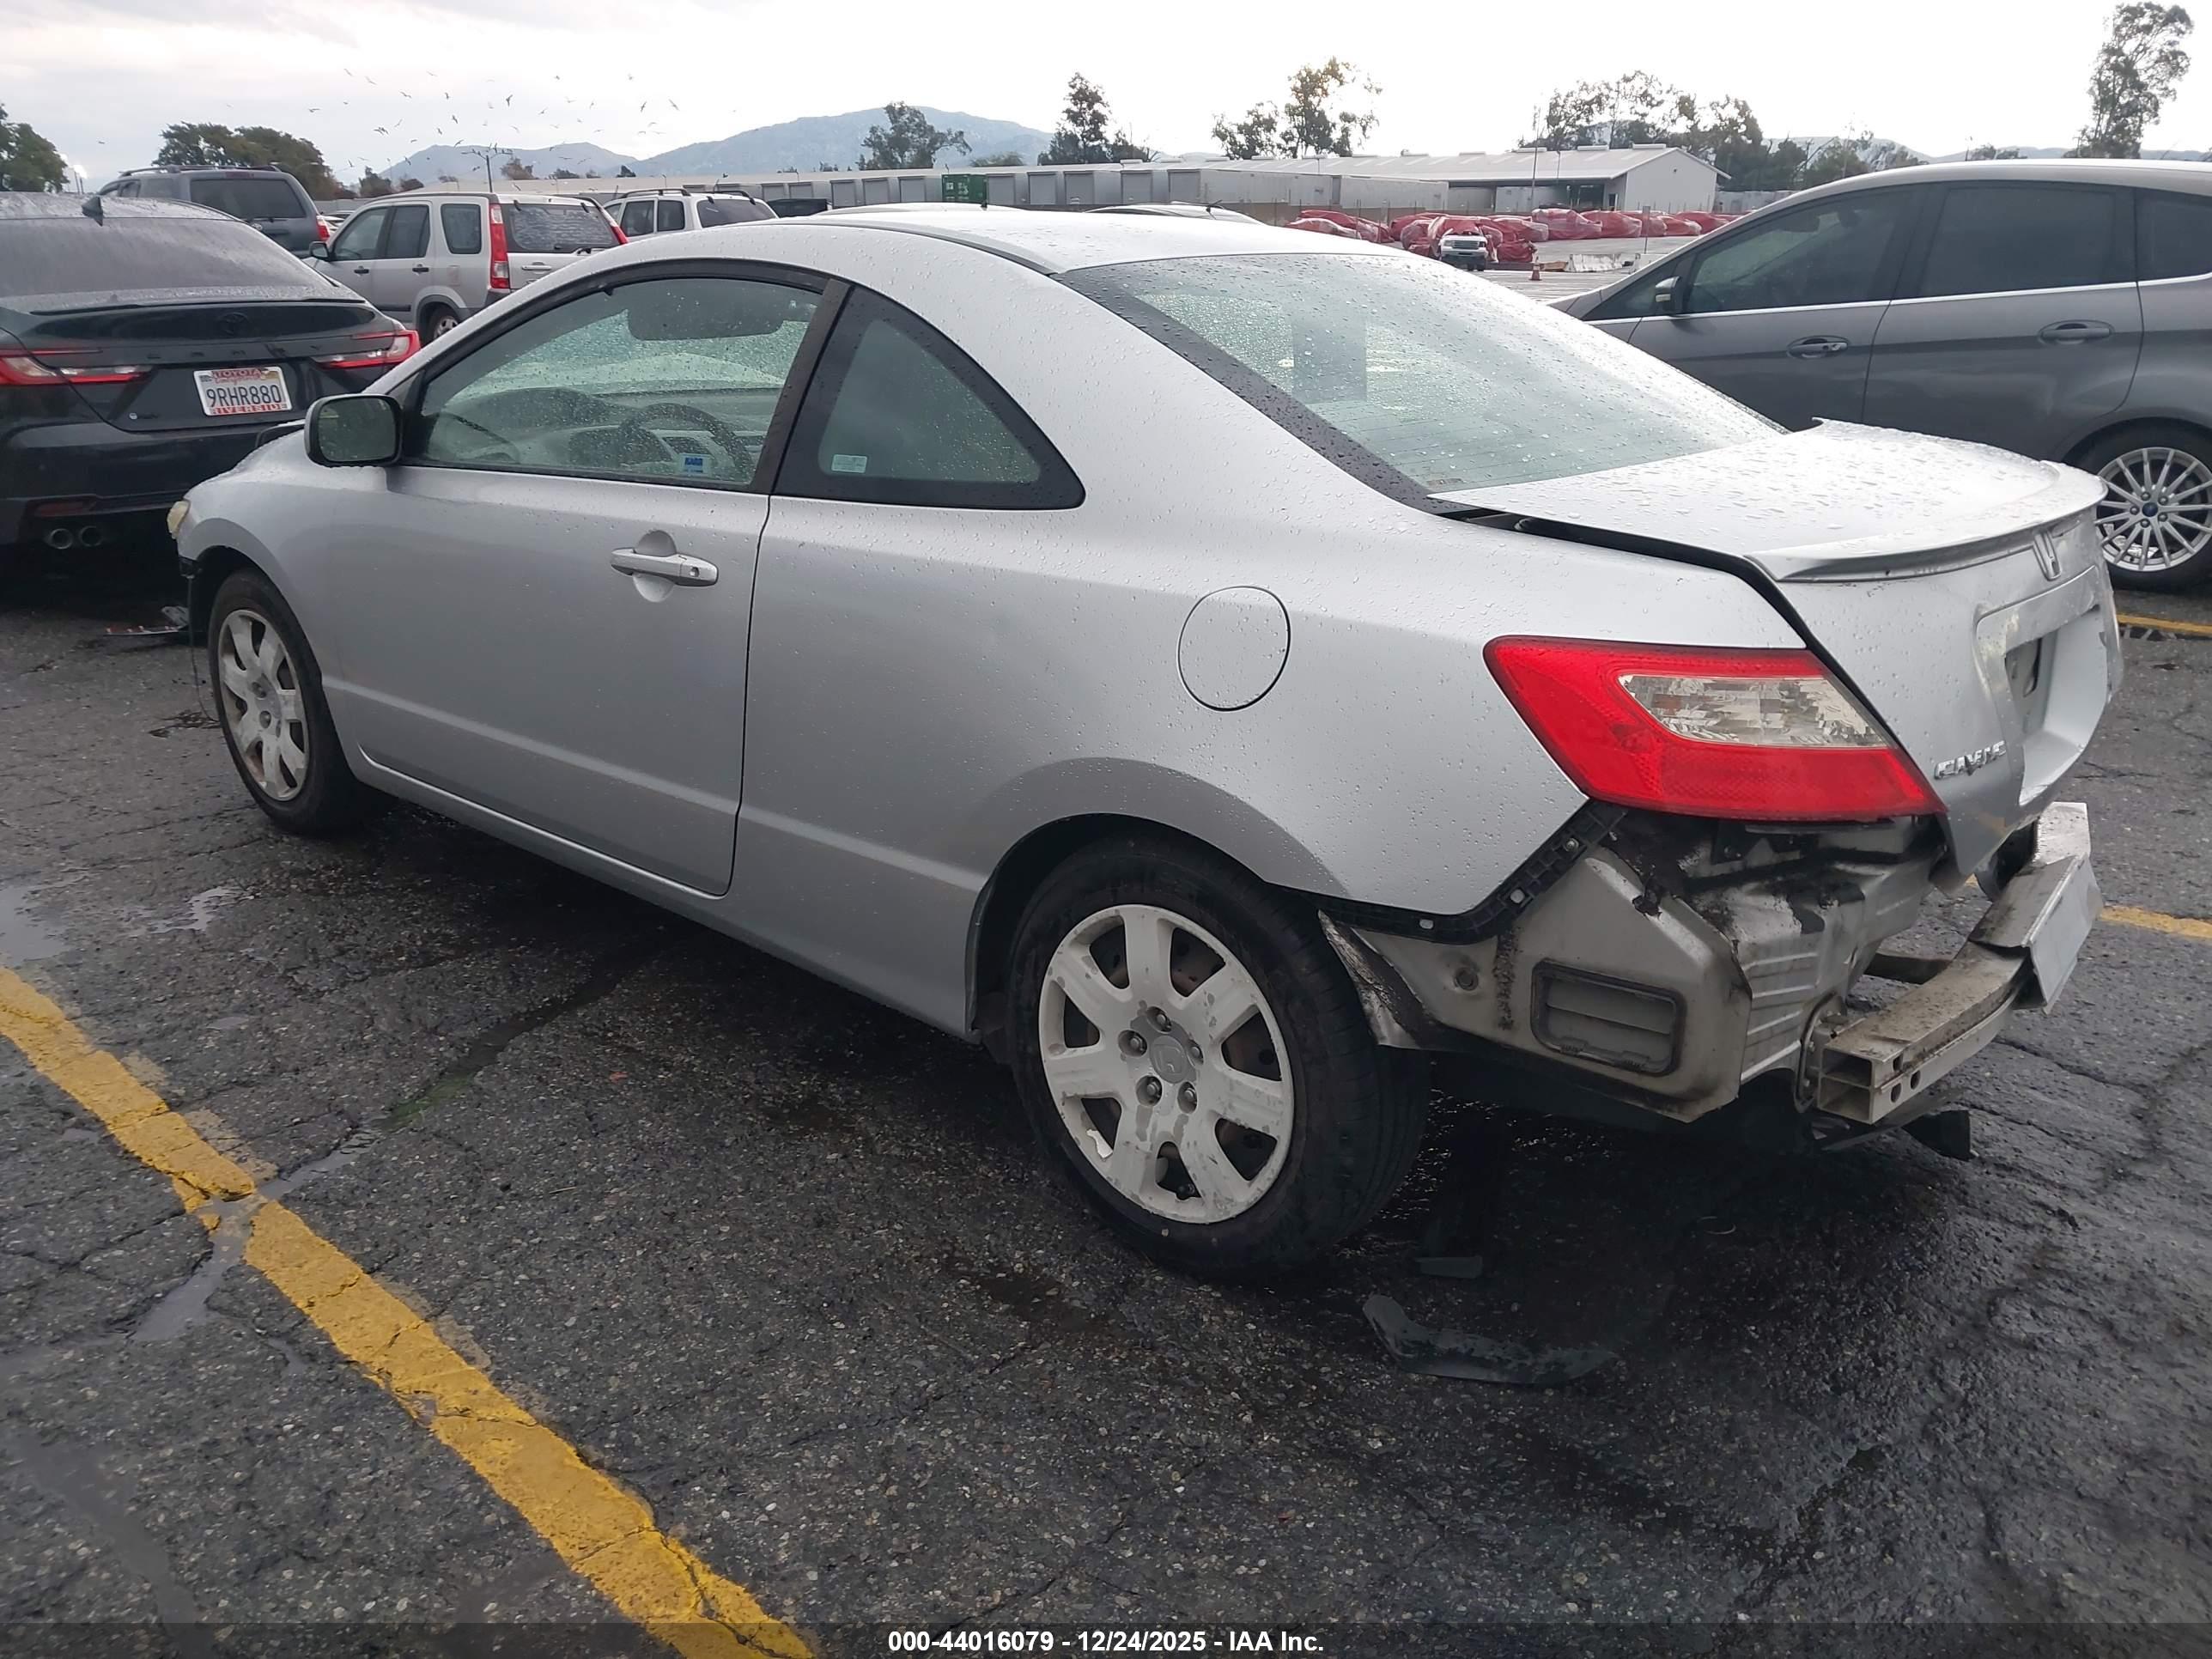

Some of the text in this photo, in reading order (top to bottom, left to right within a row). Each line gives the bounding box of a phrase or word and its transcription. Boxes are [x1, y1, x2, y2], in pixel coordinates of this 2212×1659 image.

[214, 369, 262, 380] TOYOTA
[206, 385, 282, 408] 9RHR880
[210, 404, 287, 415] RIVERSIDE
